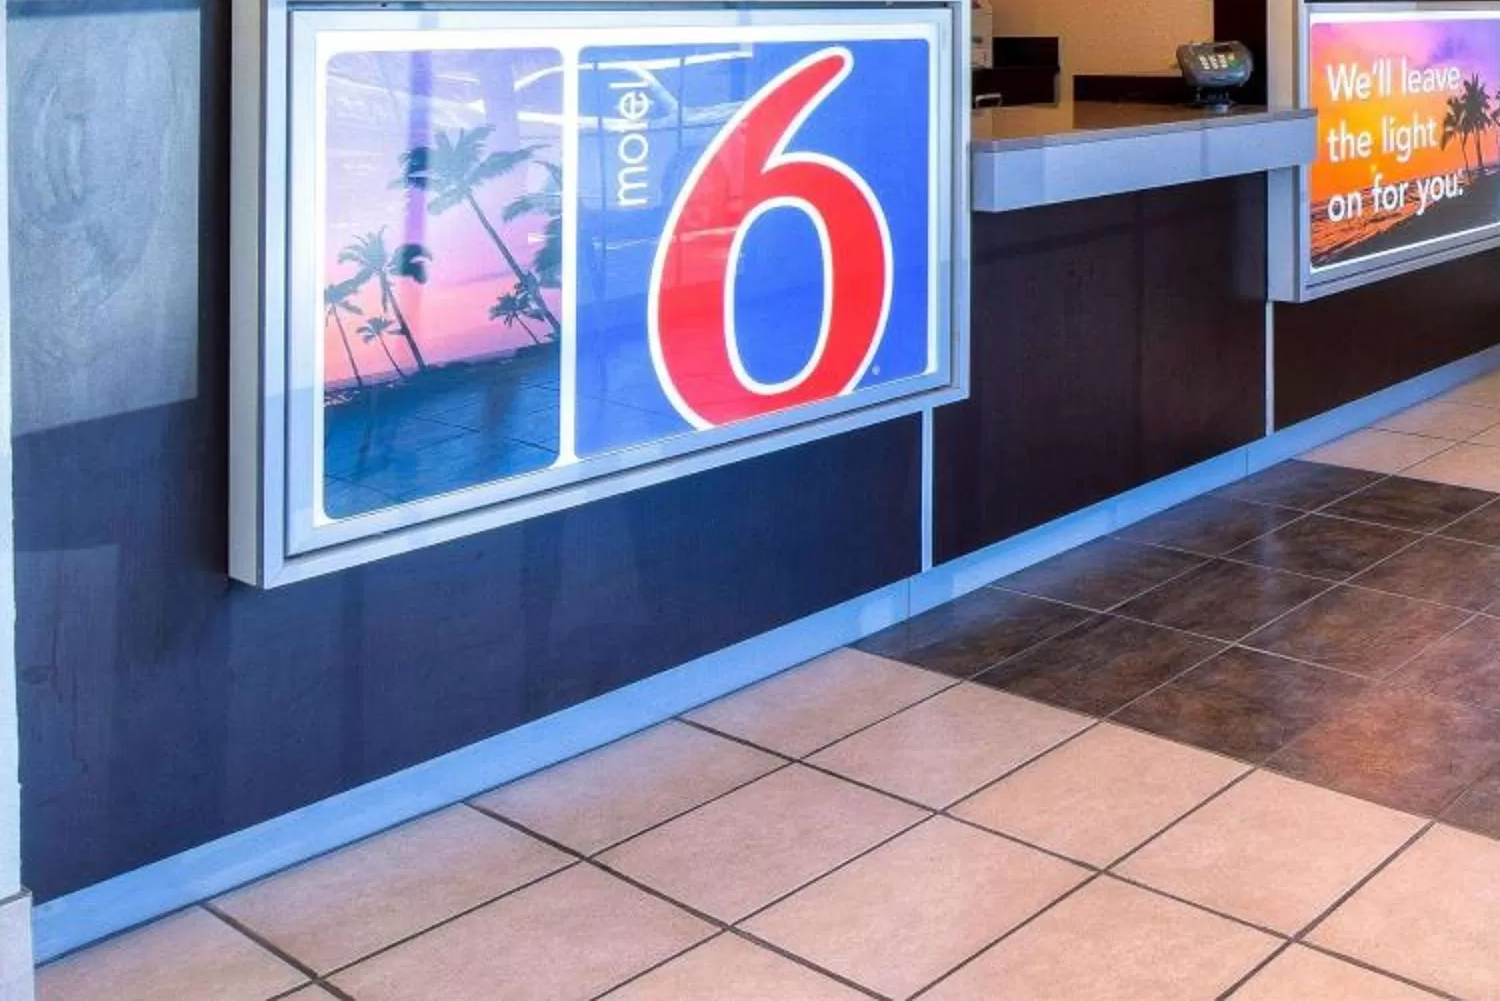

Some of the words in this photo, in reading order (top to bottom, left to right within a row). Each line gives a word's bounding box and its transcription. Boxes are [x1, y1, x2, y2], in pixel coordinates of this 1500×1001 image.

[1326, 56, 1391, 102] We'll
[1402, 55, 1461, 96] leave
[609, 79, 650, 206] motel
[1327, 119, 1372, 163] the
[1382, 111, 1438, 163] light
[1327, 192, 1362, 222] on
[1372, 173, 1408, 213] for
[648, 46, 893, 431] 6
